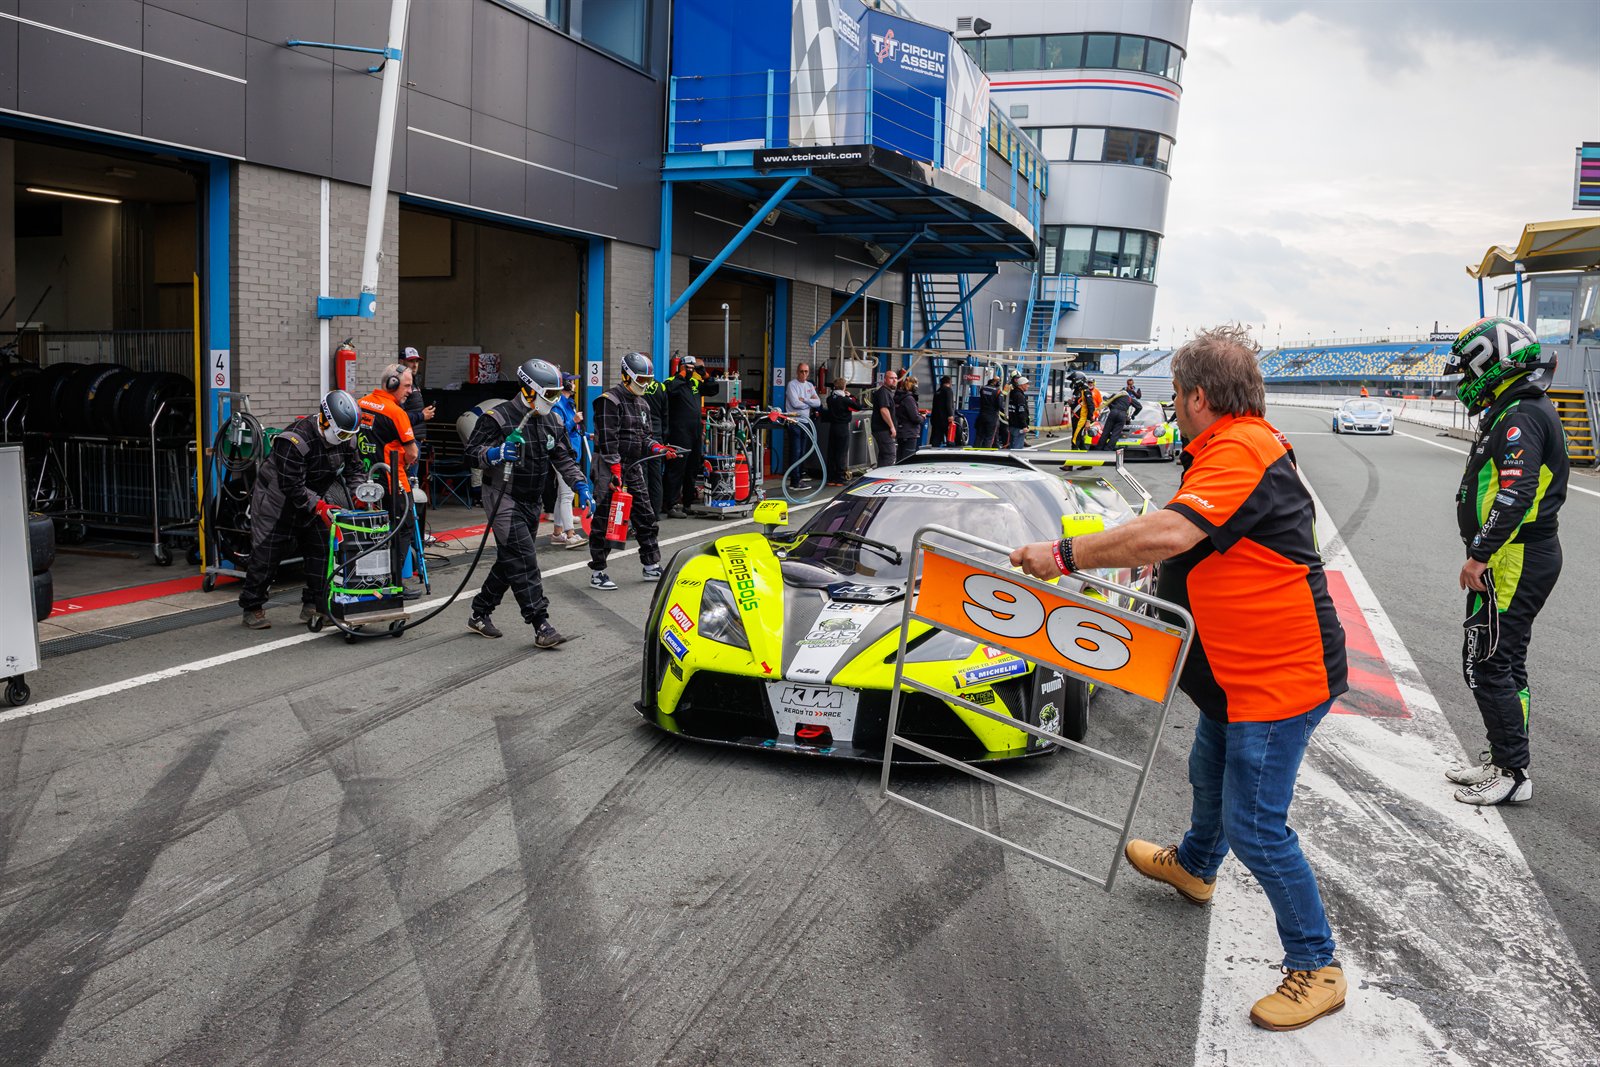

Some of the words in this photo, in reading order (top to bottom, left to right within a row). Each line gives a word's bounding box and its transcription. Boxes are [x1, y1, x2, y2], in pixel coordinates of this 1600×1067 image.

[901, 42, 946, 63] CIRCUIT
[900, 53, 945, 74] ASSEN
[763, 152, 862, 163] www.ttcircuit.com
[215, 353, 225, 371] 4
[591, 363, 599, 375] 3
[776, 369, 783, 378] 2
[669, 605, 693, 633] MOTUL
[962, 573, 1134, 671] 96
[805, 630, 861, 641] GAS
[978, 664, 1019, 679] MICHELIN
[1041, 678, 1063, 695] PUMA
[780, 683, 844, 709] KTM
[783, 707, 804, 716] READY
